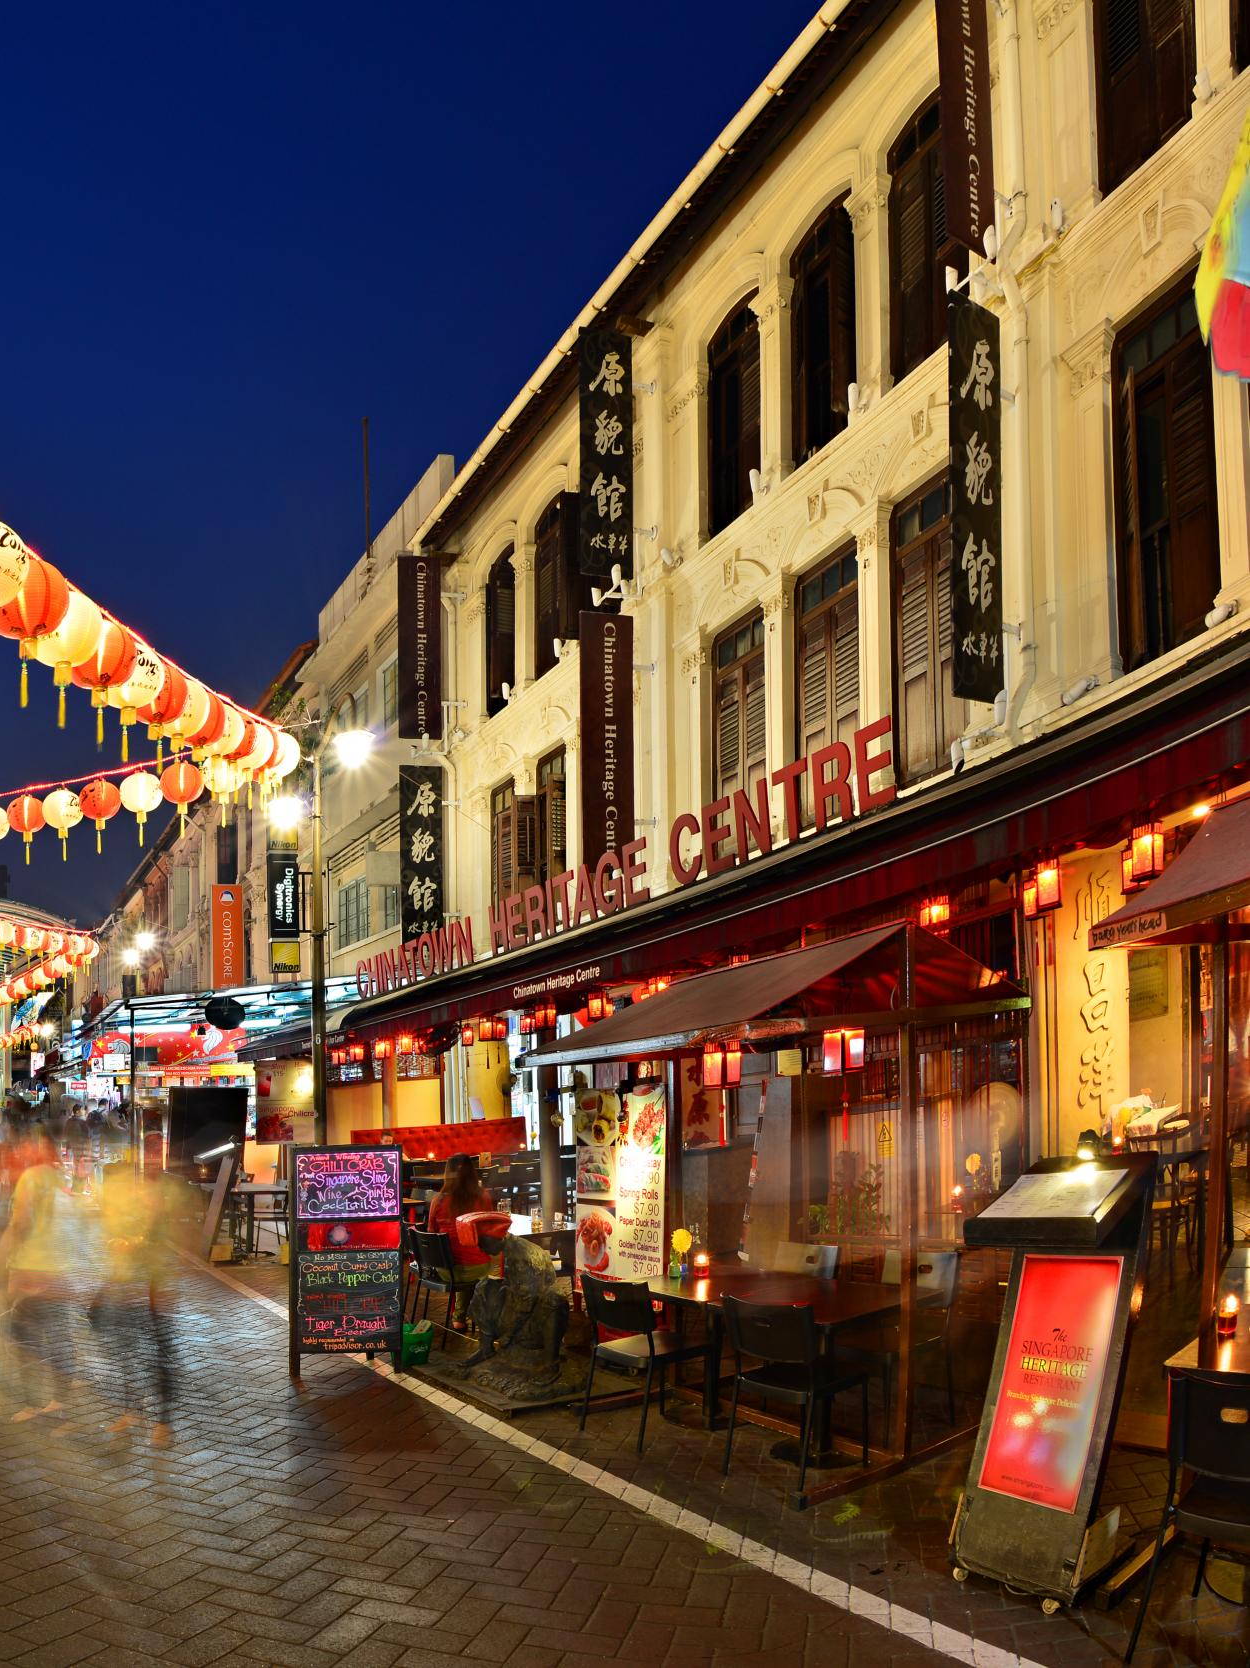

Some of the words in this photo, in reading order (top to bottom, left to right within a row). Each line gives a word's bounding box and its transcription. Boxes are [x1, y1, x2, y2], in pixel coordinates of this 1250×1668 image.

[962, 43, 978, 148] Heritage
[967, 153, 981, 239] Centre
[416, 561, 428, 629] Chinatown
[414, 633, 428, 687] Heritage
[603, 621, 616, 718] Chinatown
[417, 690, 429, 734] Centre
[601, 724, 617, 801] Heritage
[355, 916, 474, 999] CHINATOWN
[488, 836, 651, 956] HERITAGE
[670, 714, 897, 888] CENTRE
[274, 882, 286, 922] Synergy
[284, 867, 295, 925] Digitronics
[273, 962, 300, 972] Nikon
[513, 980, 546, 1000] Chinatown
[546, 973, 575, 990] Heritage
[575, 965, 601, 983] Centre
[315, 1033, 322, 1045] 6
[309, 1160, 345, 1173] CHILI
[347, 1158, 385, 1172] CRAB
[311, 1173, 360, 1188] Singapore
[360, 1169, 392, 1187] Sling
[316, 1187, 343, 1203] Wine
[355, 1185, 395, 1202] Spirits
[619, 1187, 641, 1200] Spring
[641, 1188, 659, 1200] Rolls
[307, 1199, 379, 1214] Cocktails
[633, 1202, 660, 1216] $7.90
[618, 1216, 635, 1227] Paper
[635, 1218, 650, 1228] Duck
[649, 1219, 661, 1228] Roll
[632, 1229, 659, 1244] $7.90
[618, 1239, 636, 1250] Golden
[636, 1242, 660, 1253] Calamari
[314, 1253, 325, 1261] No
[356, 1252, 367, 1260] No
[367, 1252, 387, 1260] GST
[618, 1250, 627, 1258] with
[626, 1251, 648, 1262] pineapple
[647, 1255, 661, 1263] sauce
[302, 1262, 340, 1273] Coconut
[340, 1261, 369, 1273] Curry
[368, 1259, 394, 1271] Crab
[632, 1260, 659, 1276] $7.90
[305, 1272, 335, 1287] Black
[337, 1271, 371, 1287] Pepper
[305, 1317, 335, 1333] Tiger
[341, 1315, 388, 1332] Draught
[333, 1328, 366, 1337] Beer
[1052, 1327, 1068, 1343] The
[1021, 1340, 1095, 1363] SINGAPORE
[1021, 1356, 1089, 1379] HERITAGE
[1022, 1372, 1084, 1393] RESTAURANT
